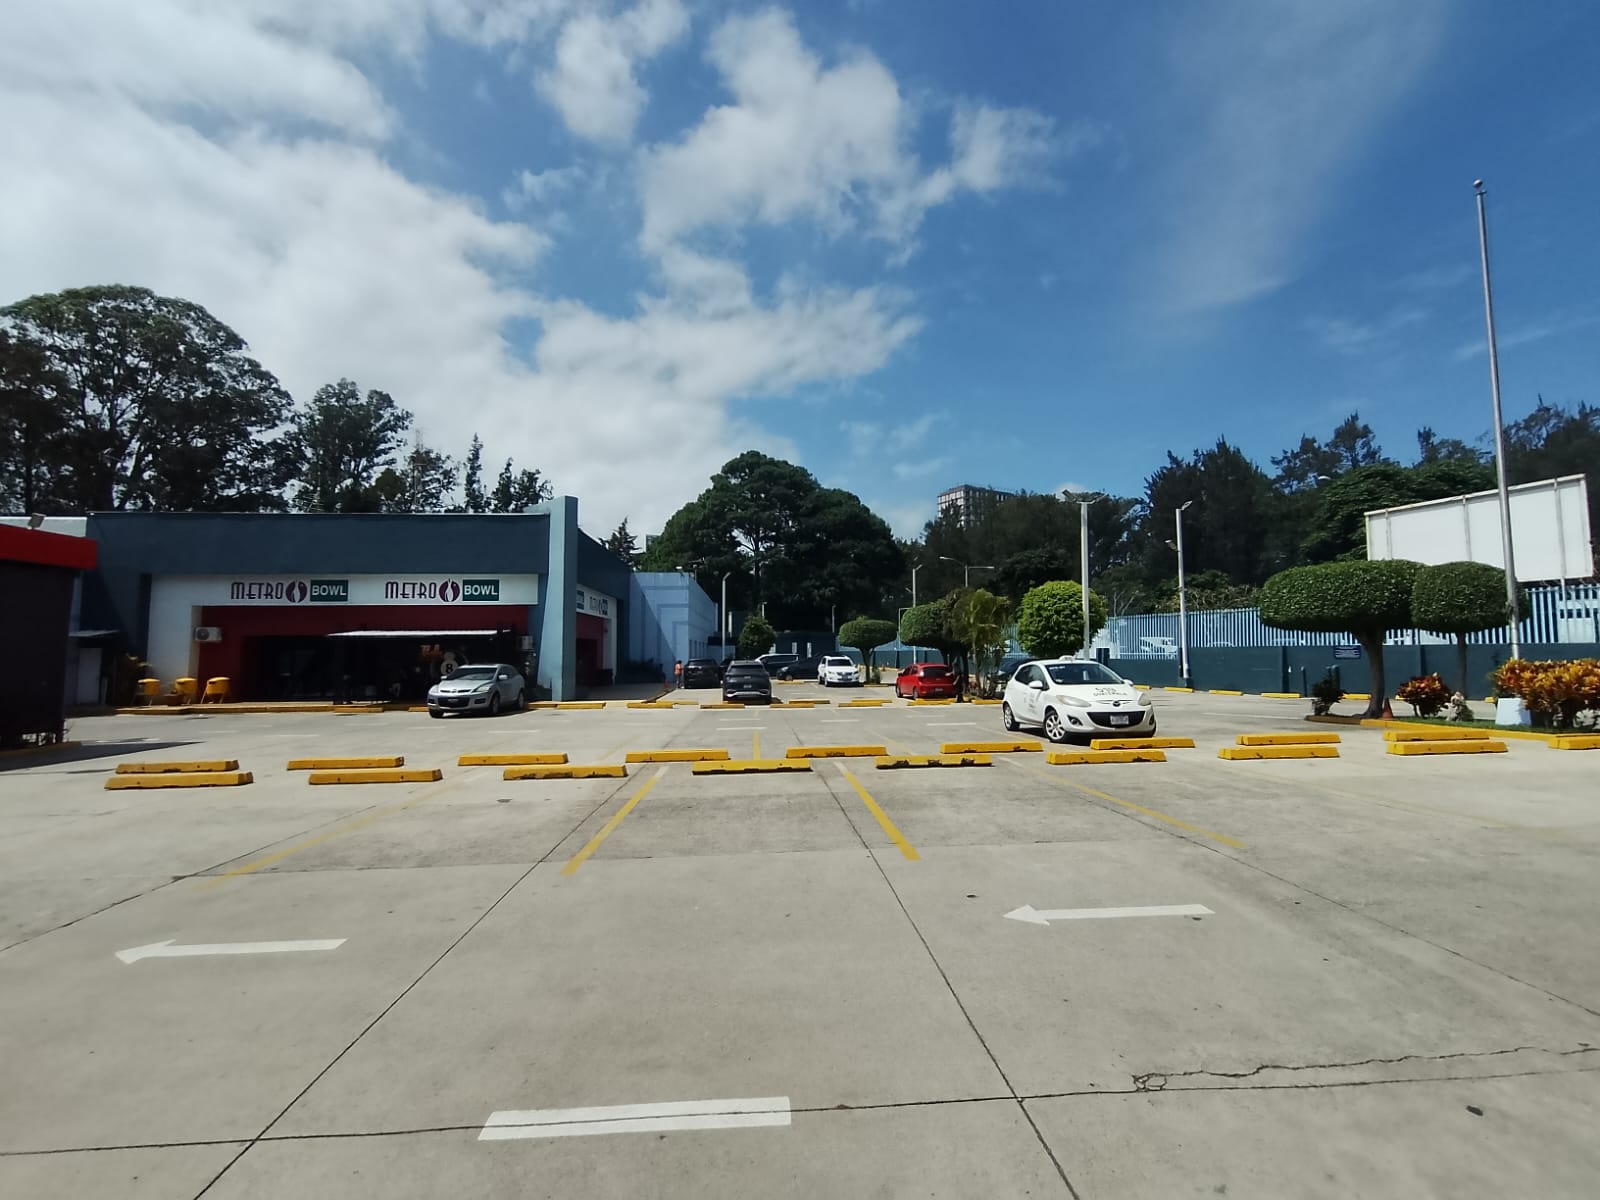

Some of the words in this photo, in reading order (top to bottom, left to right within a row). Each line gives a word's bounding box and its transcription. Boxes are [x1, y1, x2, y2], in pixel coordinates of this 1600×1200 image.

[231, 582, 284, 600] METRO
[312, 585, 347, 596] BOWL
[385, 581, 437, 599] METRO
[464, 584, 498, 596] BOWL
[446, 663, 453, 674] 8
